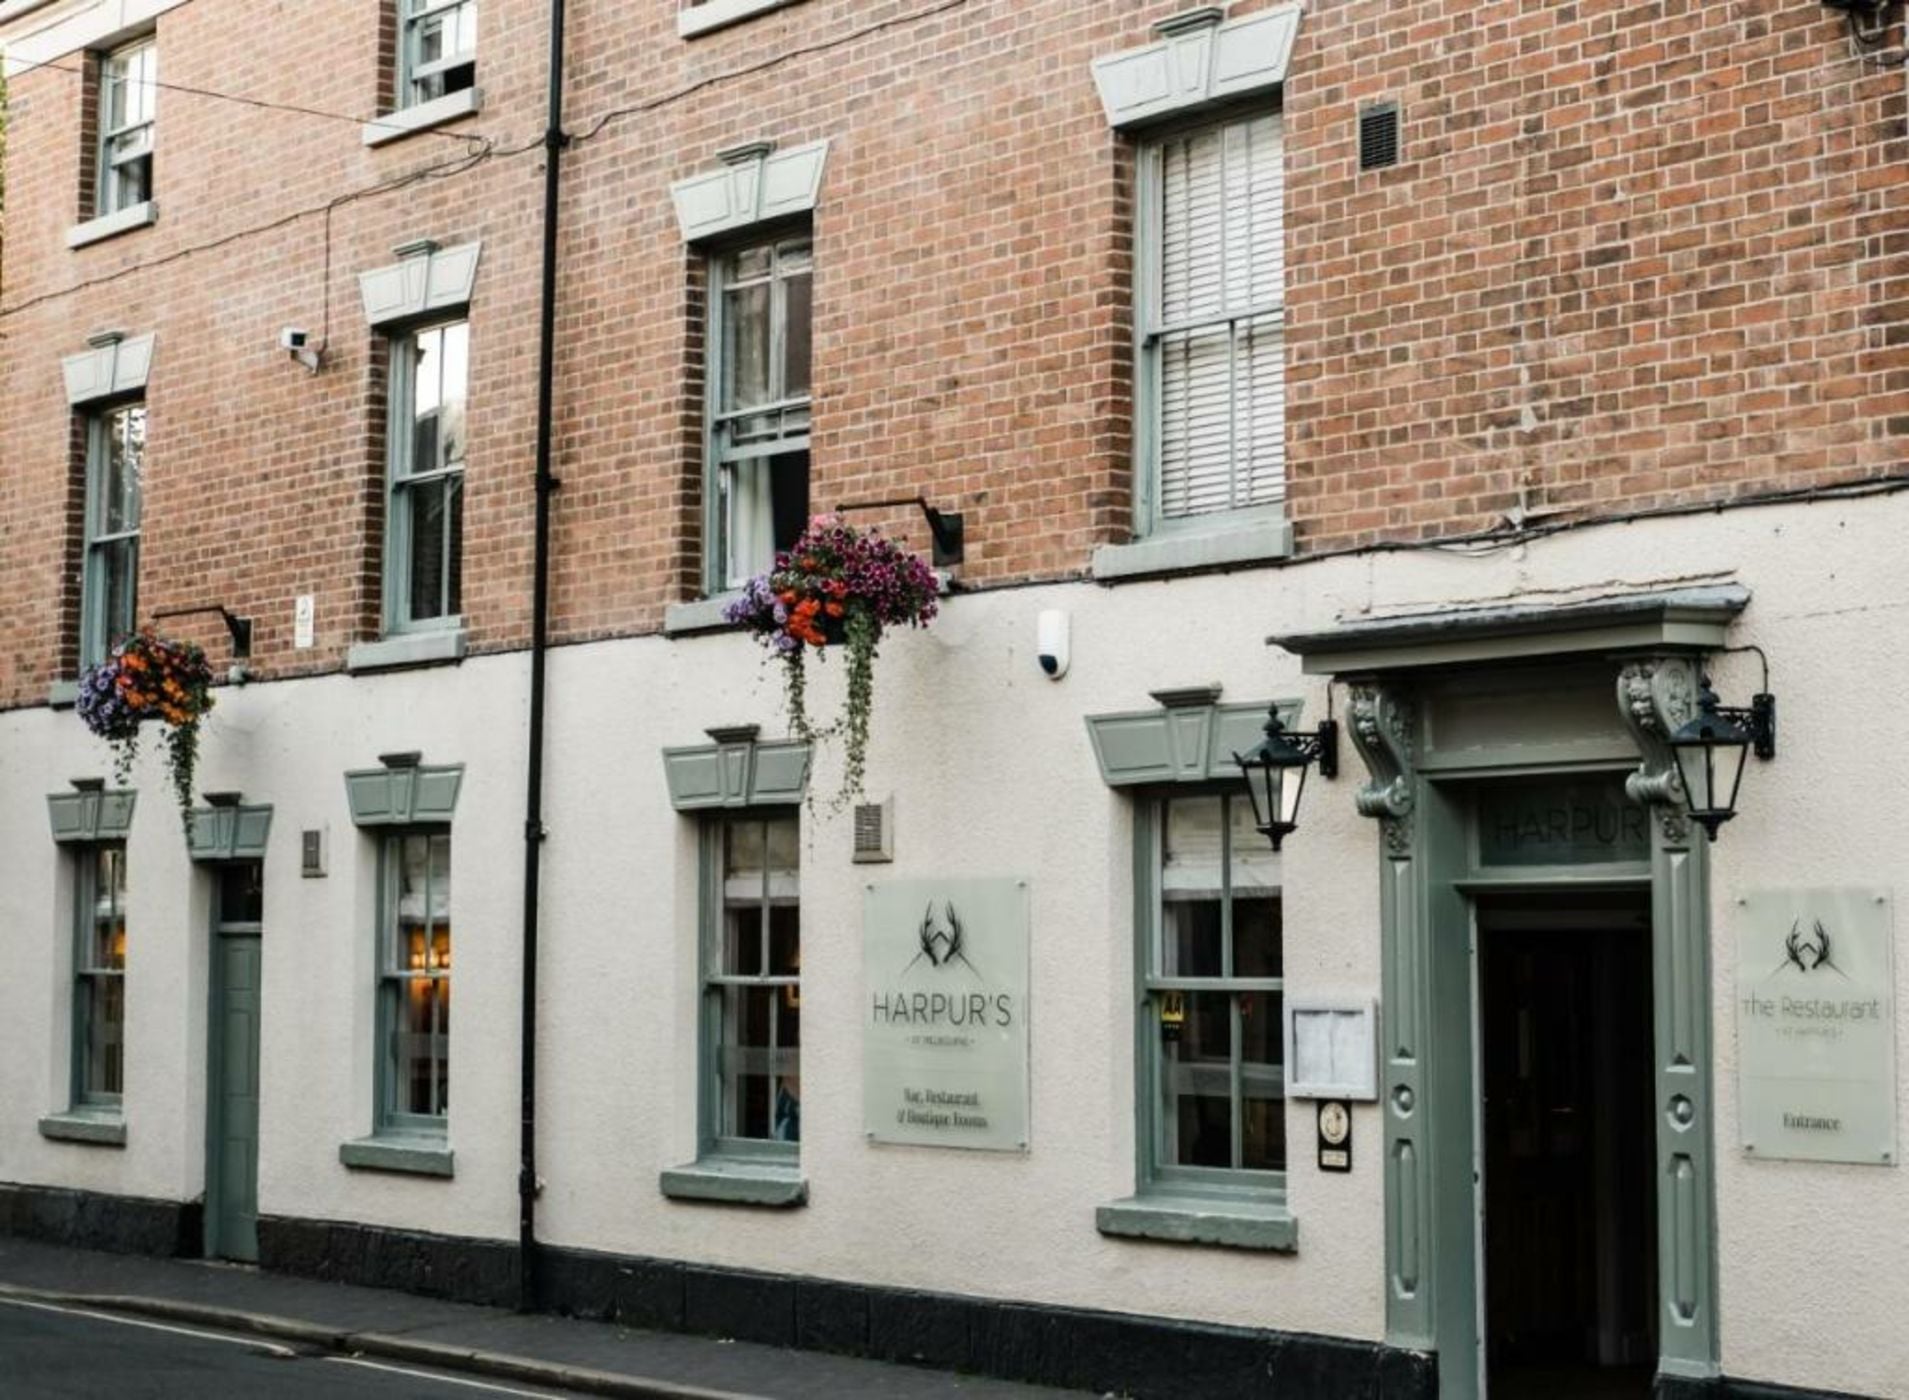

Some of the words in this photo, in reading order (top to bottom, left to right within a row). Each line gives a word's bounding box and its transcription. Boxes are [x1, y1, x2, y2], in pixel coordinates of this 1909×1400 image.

[873, 991, 1012, 1027] HARPUR'S
[1781, 995, 1880, 1019] Restaurant
[1783, 1111, 1841, 1131] Entrance
